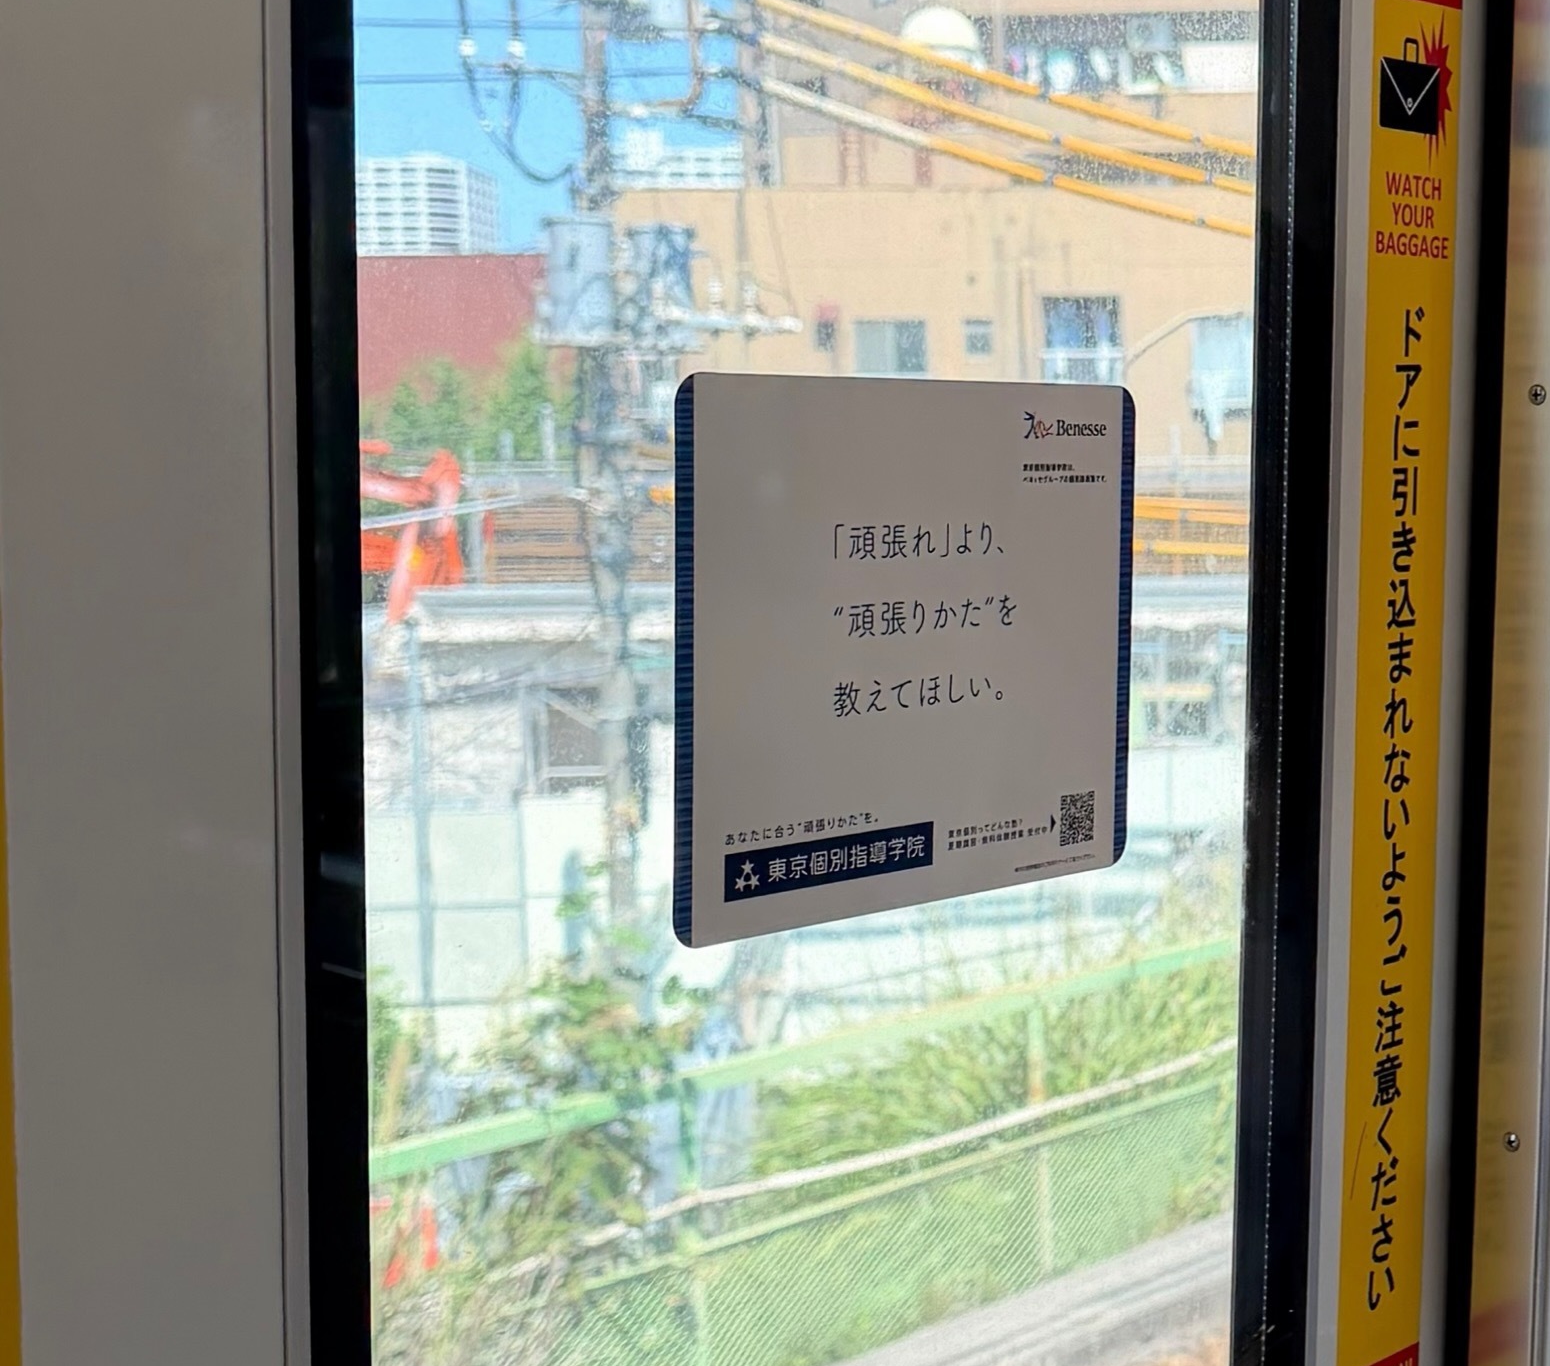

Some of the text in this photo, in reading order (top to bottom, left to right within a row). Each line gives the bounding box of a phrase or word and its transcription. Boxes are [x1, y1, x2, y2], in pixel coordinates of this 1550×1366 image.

[1385, 171, 1442, 201] WATCH
[1391, 202, 1435, 230] YOUR
[1375, 230, 1449, 260] BAGGAGE
[1056, 419, 1107, 436] Benesse
[832, 522, 1005, 561] 「頑張れ」より、
[833, 674, 1004, 718] 教えてほしい。
[1368, 308, 1425, 1311] ドアに引き込まれないようご注意ください
[768, 835, 926, 883] 東京個別指導学院
